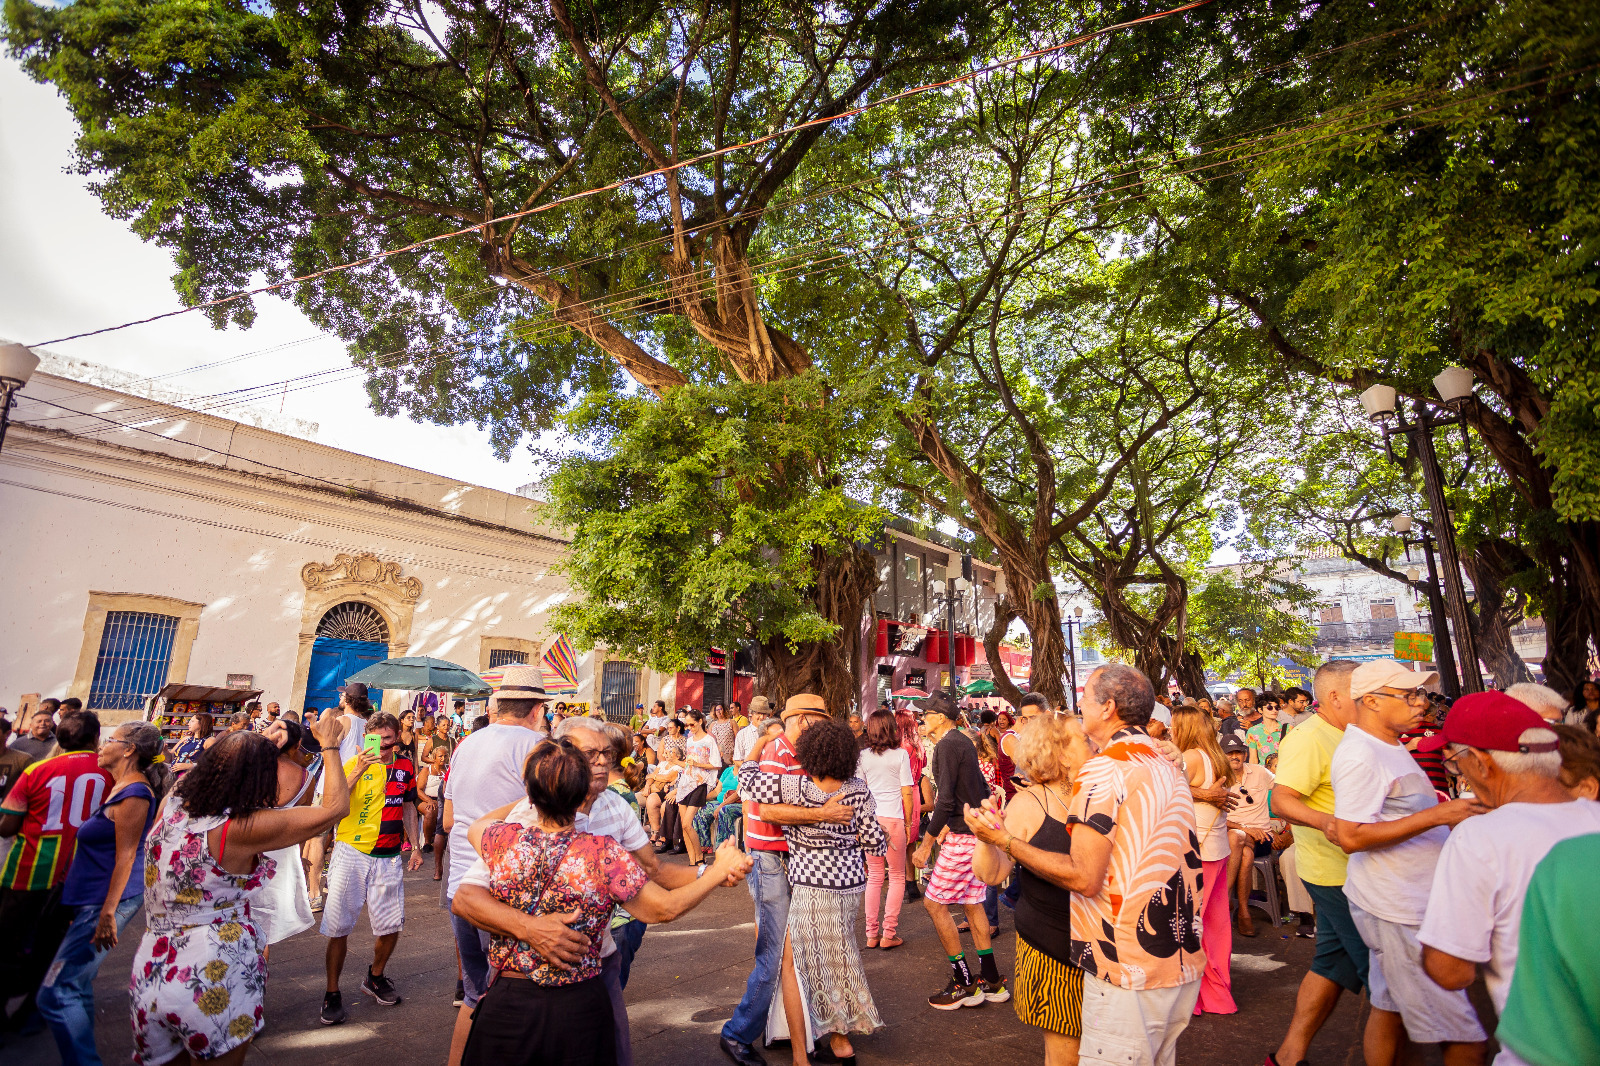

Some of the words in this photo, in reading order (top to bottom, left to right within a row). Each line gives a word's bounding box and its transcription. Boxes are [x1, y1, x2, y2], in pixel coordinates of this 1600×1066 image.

[1394, 650, 1430, 661] JAMBU
[1408, 642, 1420, 651] DE
[42, 773, 106, 831] 10
[358, 789, 373, 825] BRASIL
[958, 960, 971, 986] BRASIL
[951, 989, 966, 1000] FILA
